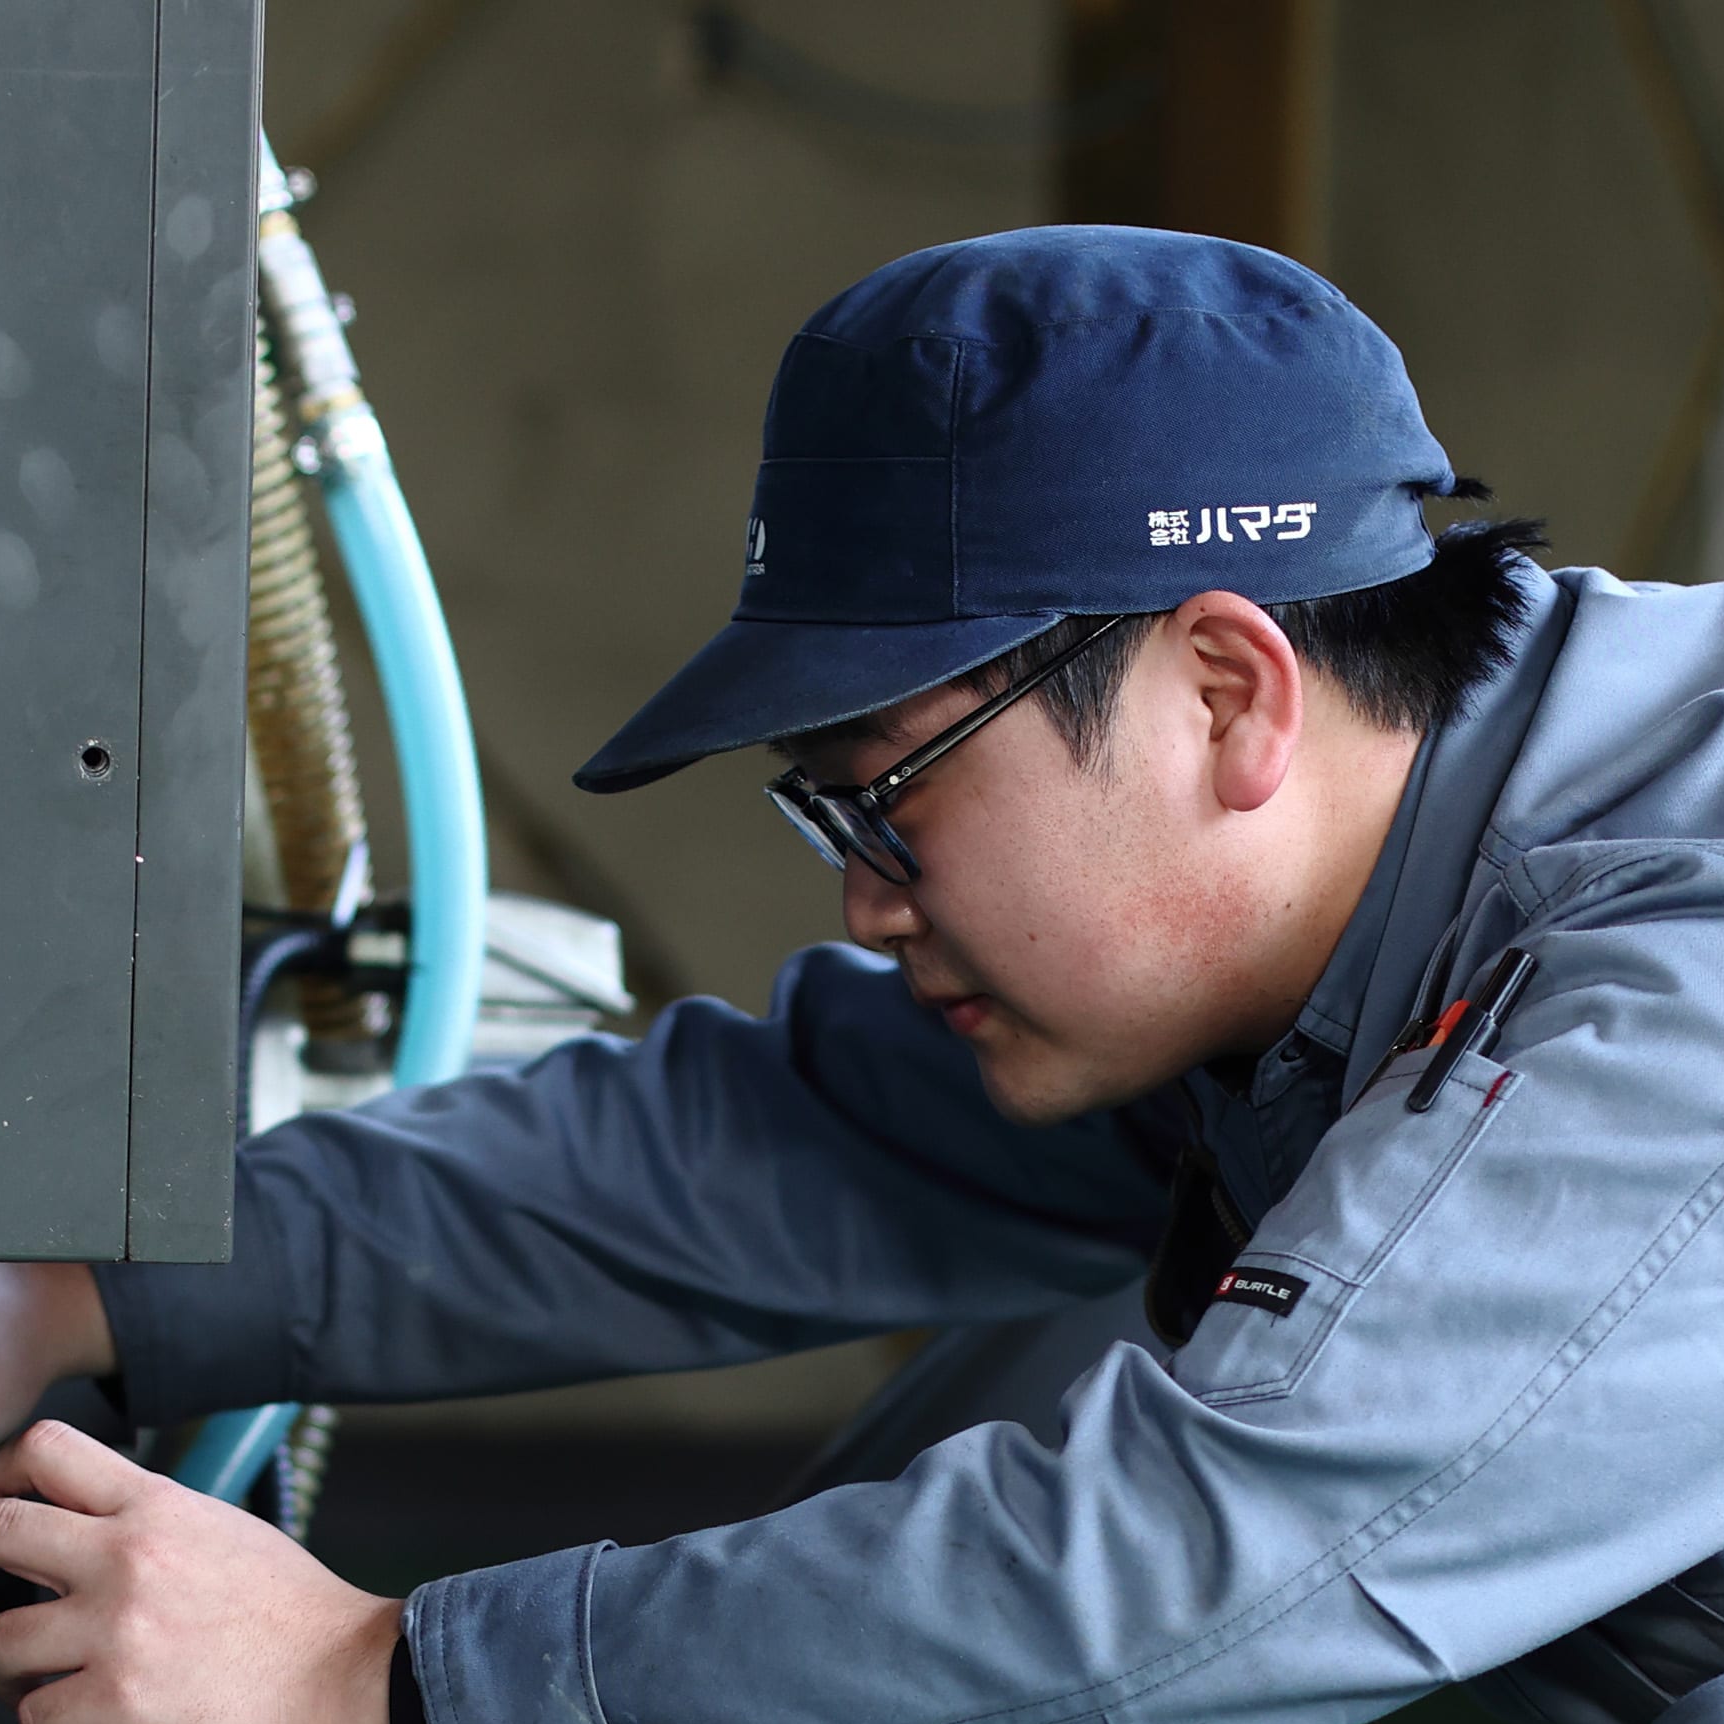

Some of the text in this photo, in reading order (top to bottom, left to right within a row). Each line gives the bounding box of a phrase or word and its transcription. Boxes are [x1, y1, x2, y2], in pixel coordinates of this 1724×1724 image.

[1196, 503, 1317, 544] ハマダ
[1234, 1279, 1291, 1300] BURTLE
